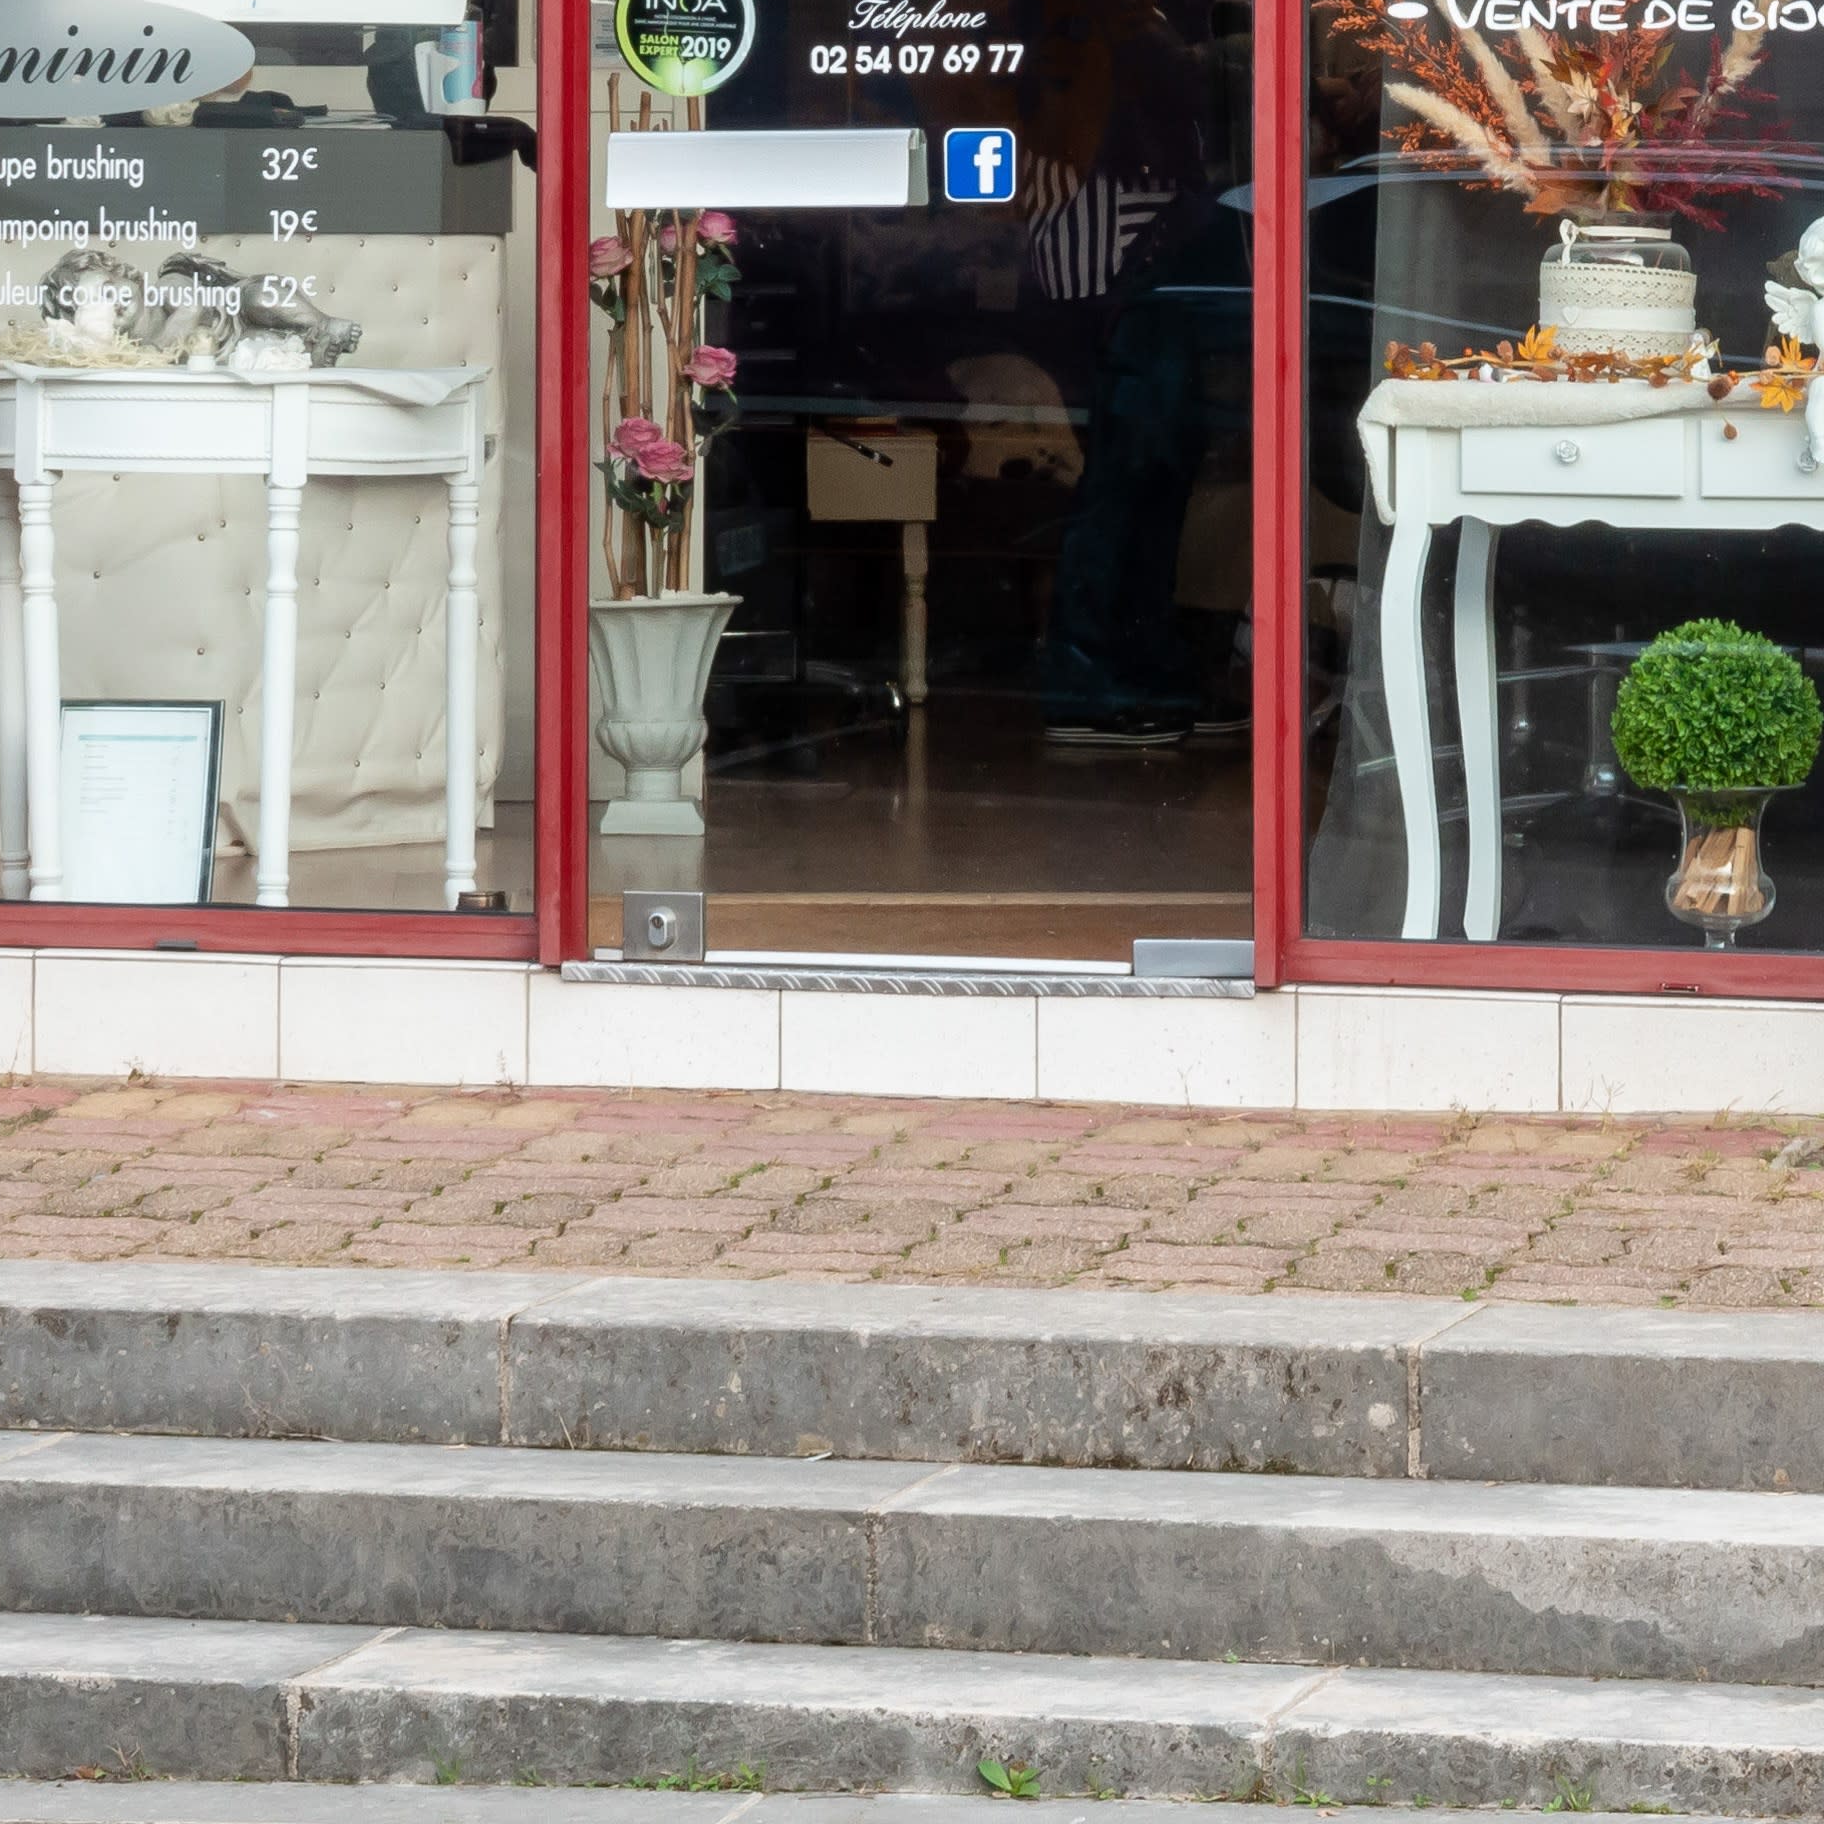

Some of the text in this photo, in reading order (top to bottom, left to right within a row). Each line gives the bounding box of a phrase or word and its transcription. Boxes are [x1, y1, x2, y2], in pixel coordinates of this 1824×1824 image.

[639, 34, 679, 45] SALON
[639, 44, 679, 56] EXPERT
[680, 35, 732, 60] 2019
[809, 43, 1025, 75] 02 54 07 69 77
[47, 143, 144, 189] brushing
[261, 146, 318, 181] 32€
[98, 207, 198, 251] brushing
[269, 209, 318, 243] 19€
[60, 281, 133, 316] coupe
[143, 272, 242, 316] brushing
[260, 274, 318, 308] 52€
